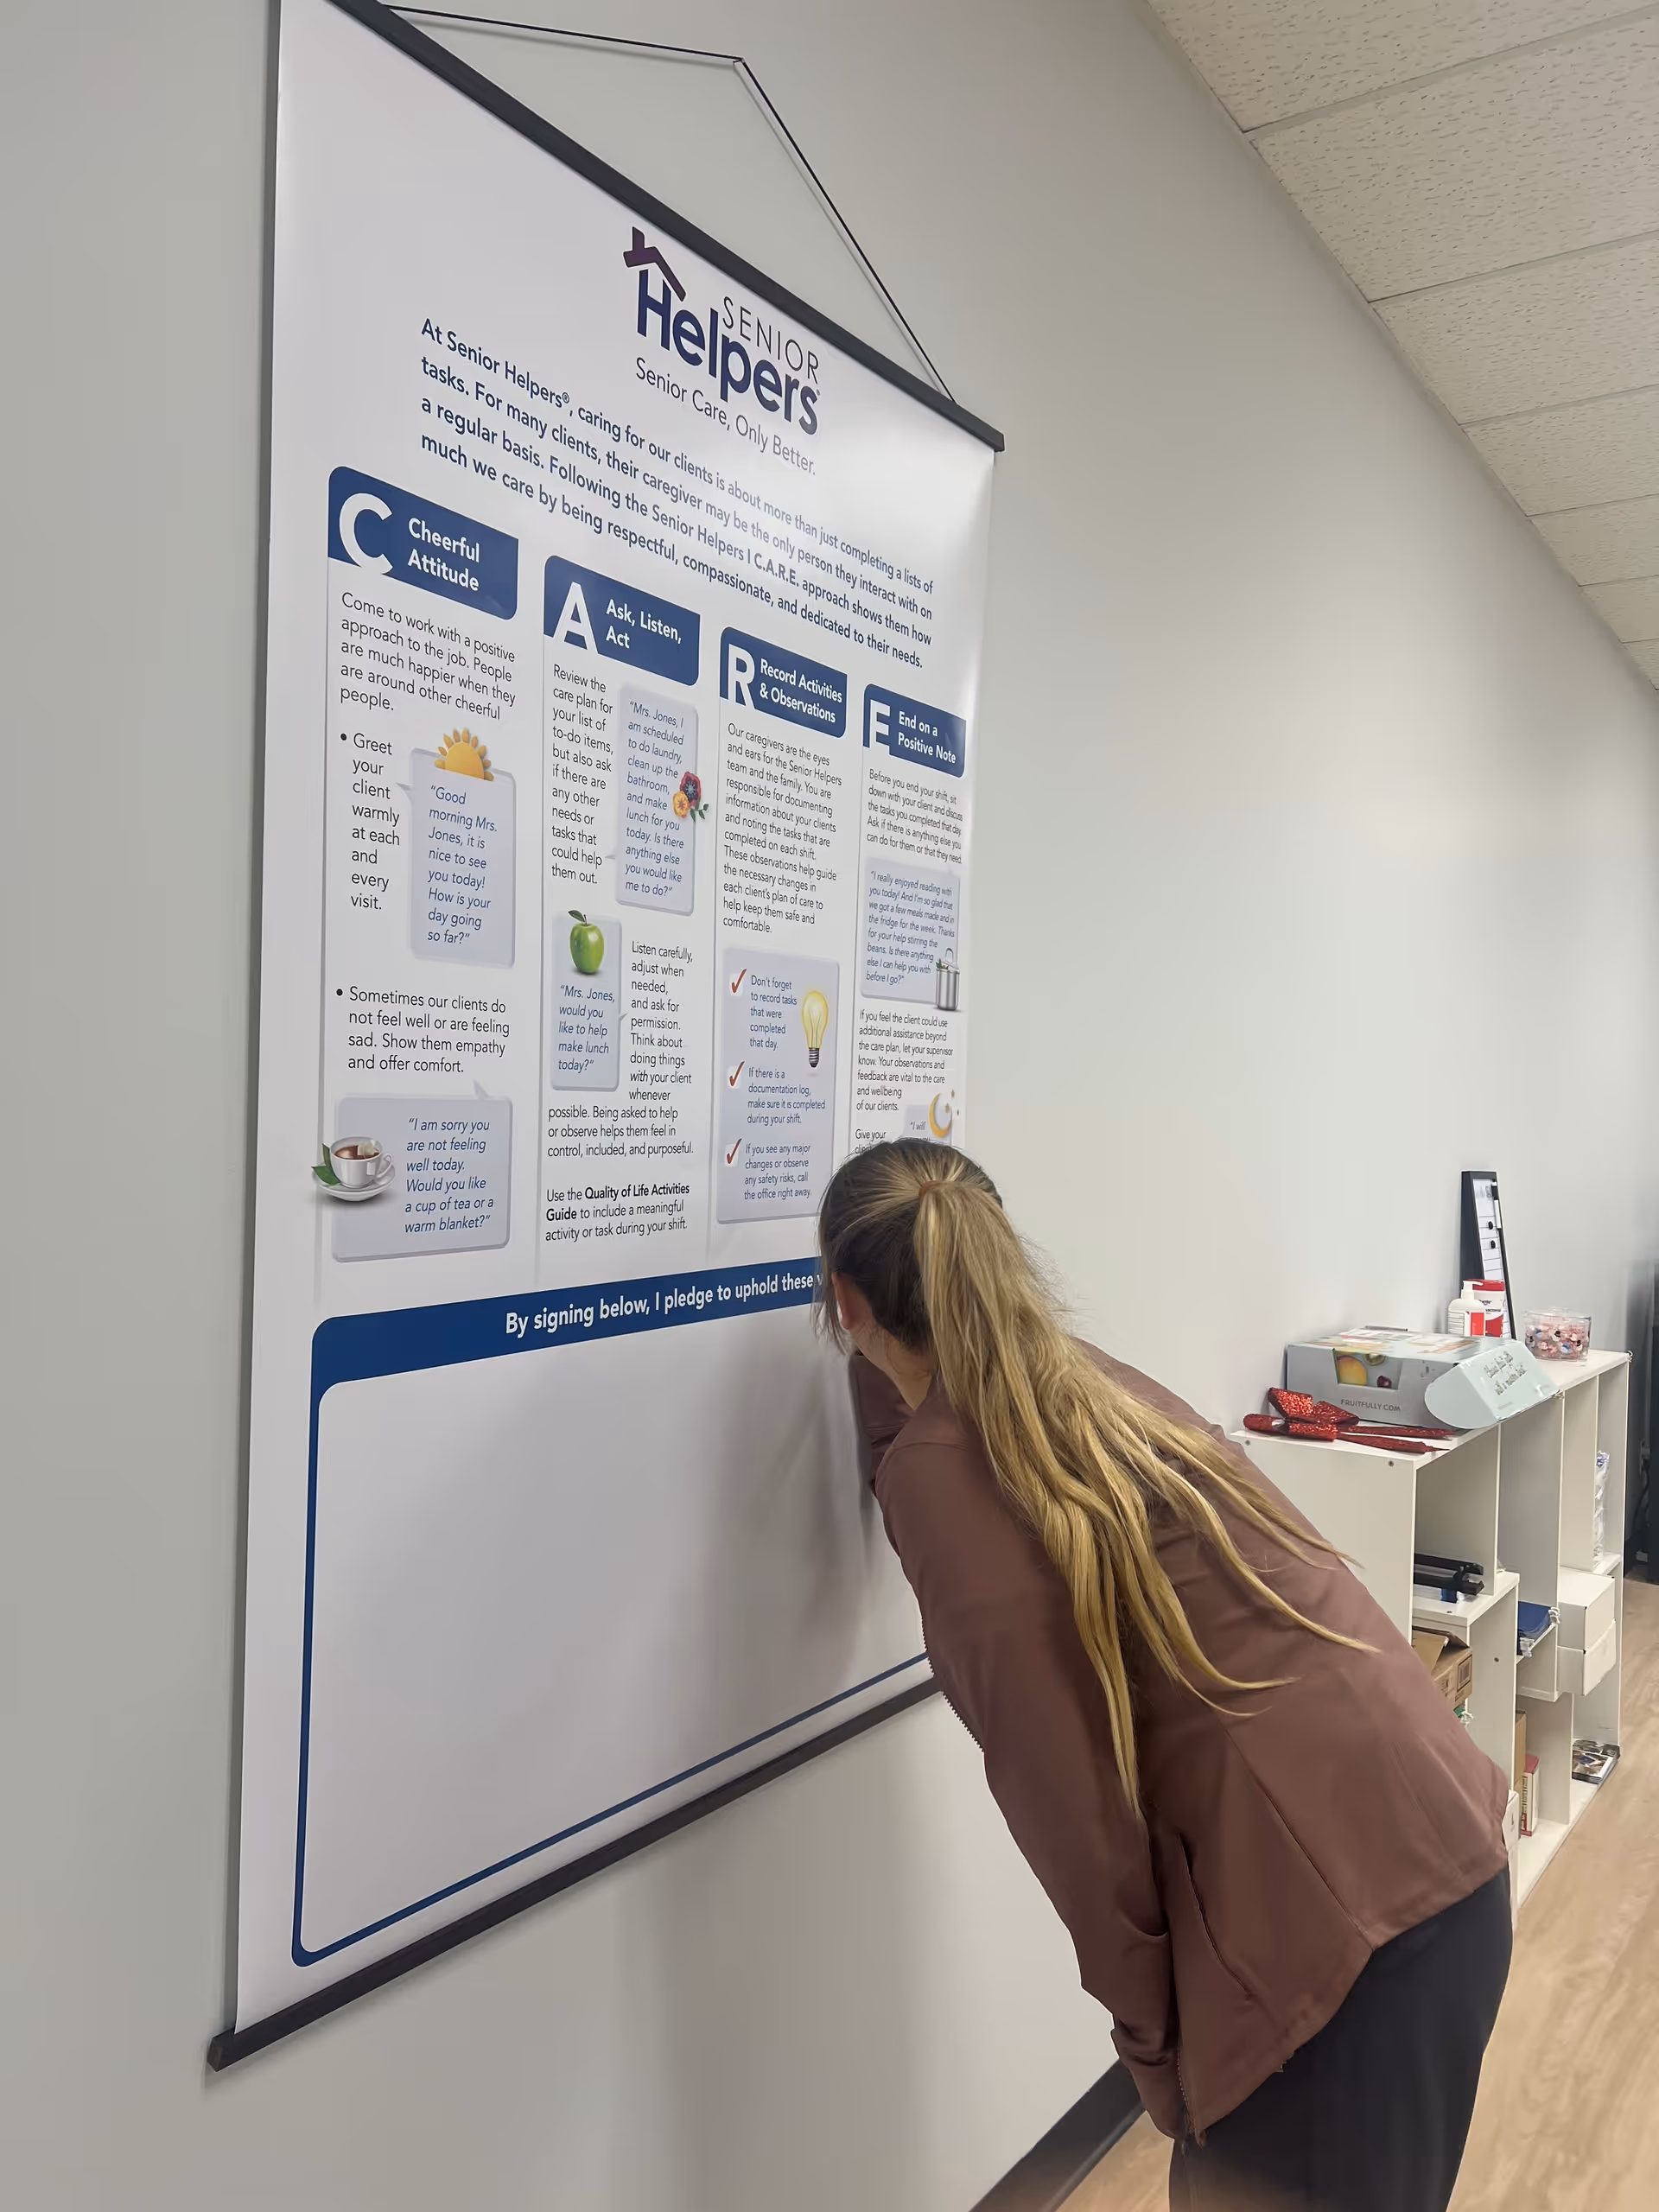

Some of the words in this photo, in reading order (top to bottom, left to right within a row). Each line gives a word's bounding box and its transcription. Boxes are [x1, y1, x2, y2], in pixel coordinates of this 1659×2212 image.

[722, 296, 819, 385] SENIOR
[636, 357, 687, 402] Senior
[692, 389, 730, 431] Care,
[735, 414, 768, 453] Only
[772, 434, 815, 475] Better.
[421, 318, 442, 345] At
[447, 330, 500, 373] Senior
[578, 407, 620, 442] caring
[624, 424, 645, 449] for
[648, 442, 671, 462] our
[674, 452, 713, 485] clients
[716, 472, 725, 491] is
[728, 480, 761, 510] about
[763, 501, 791, 524] more
[794, 514, 817, 538] than
[818, 526, 838, 549] just
[840, 541, 893, 580] completing
[895, 569, 901, 580] a
[904, 568, 921, 589] lists
[923, 580, 933, 594] of
[421, 356, 469, 396] tasks.
[475, 381, 503, 411] For
[506, 403, 547, 439] many
[551, 424, 601, 465] clients,
[606, 450, 639, 479] their
[642, 472, 702, 510] caregiver
[705, 502, 730, 527] may
[733, 510, 748, 532] be
[750, 521, 769, 543] the
[772, 536, 795, 559] only
[798, 548, 832, 574] person
[835, 563, 857, 589] they
[859, 574, 896, 604] interact
[898, 595, 918, 613] with
[920, 607, 931, 620] on
[339, 492, 393, 575] C
[421, 397, 430, 414] a
[437, 404, 498, 444] regular
[502, 429, 544, 469] basis.
[550, 454, 620, 509] Following
[624, 493, 648, 516] the
[652, 504, 694, 537] Senior
[697, 524, 744, 561] Helpers
[753, 552, 799, 587] C.A.R.E.
[802, 579, 849, 610] approach
[852, 600, 882, 625] shows
[884, 613, 909, 637] them
[912, 624, 931, 645] how
[409, 518, 480, 563] Cheerful
[422, 435, 467, 468] much
[473, 458, 497, 480] we
[502, 473, 534, 499] care
[539, 483, 556, 513] by
[562, 494, 602, 534] being
[607, 521, 678, 565] respectful,
[683, 555, 774, 607] compassionate,
[777, 597, 798, 615] and
[800, 604, 850, 639] dedicated
[853, 628, 864, 644] to
[866, 632, 890, 654] their
[892, 646, 922, 668] needs.
[407, 548, 479, 591] Attitude
[341, 592, 385, 618] Come
[388, 608, 402, 623] to
[405, 615, 435, 635] work
[437, 626, 461, 644] with
[464, 636, 471, 647] a
[474, 639, 515, 663] positive
[553, 581, 599, 655] A
[605, 625, 630, 649] Act
[606, 599, 635, 626] Ask,
[640, 610, 681, 644] Listen,
[341, 619, 404, 646] approach
[407, 637, 420, 652] to
[423, 640, 443, 659] the
[446, 647, 469, 668] job.
[474, 656, 512, 683] People
[340, 664, 363, 679] are
[368, 671, 415, 694] around
[419, 685, 452, 704] other
[454, 694, 499, 720] cheerful
[341, 642, 364, 657] are
[368, 649, 404, 669] much
[408, 656, 455, 684] happier
[458, 675, 488, 696] when
[492, 684, 515, 707] they
[553, 664, 588, 687] Review
[589, 677, 606, 693] the
[728, 643, 756, 710] R
[760, 658, 796, 686] Record
[798, 673, 842, 703] Activities
[340, 687, 393, 710] people.
[553, 688, 574, 702] care
[575, 692, 597, 709] plan
[599, 697, 613, 714] for
[759, 682, 768, 700] &
[770, 686, 836, 723] Observations
[899, 710, 916, 729] End
[918, 721, 930, 734] on
[931, 726, 938, 737] a
[353, 732, 392, 755] Greet
[728, 722, 744, 737] Our
[745, 732, 784, 752] caregivers
[785, 745, 797, 756] are
[798, 748, 811, 760] the
[812, 753, 830, 766] eyes
[898, 731, 933, 756] Positive
[935, 744, 956, 764] Note
[353, 759, 384, 775] your
[869, 768, 891, 785] Before
[892, 778, 905, 789] you
[906, 782, 918, 792] end
[919, 787, 934, 797] your
[935, 789, 949, 804] shift,
[353, 778, 391, 799] client
[352, 804, 399, 827] warmly
[352, 826, 365, 840] at
[369, 830, 399, 845] each
[352, 849, 377, 864] and
[351, 873, 389, 892] every
[351, 893, 381, 910] visit.
[632, 941, 656, 955] Listen
[658, 945, 692, 963] carefully,
[772, 976, 791, 992] forget
[420, 1121, 437, 1130] am
[440, 1122, 468, 1135] sorry
[469, 1122, 489, 1134] you
[547, 1189, 565, 1202] Use
[566, 1187, 582, 1200] the
[584, 1185, 619, 1202] Quality
[620, 1184, 632, 1198] of
[632, 1183, 649, 1197] Life
[651, 1182, 690, 1196] Activities
[505, 1312, 529, 1338] By
[533, 1303, 594, 1333] signing
[600, 1294, 650, 1319] below,
[655, 1291, 659, 1310] I
[664, 1285, 713, 1314] pledge
[716, 1284, 731, 1300] to
[734, 1274, 778, 1302] uphold
[781, 1272, 813, 1291] these
[1340, 1398, 1402, 1412] FRUITFULLY.COM
